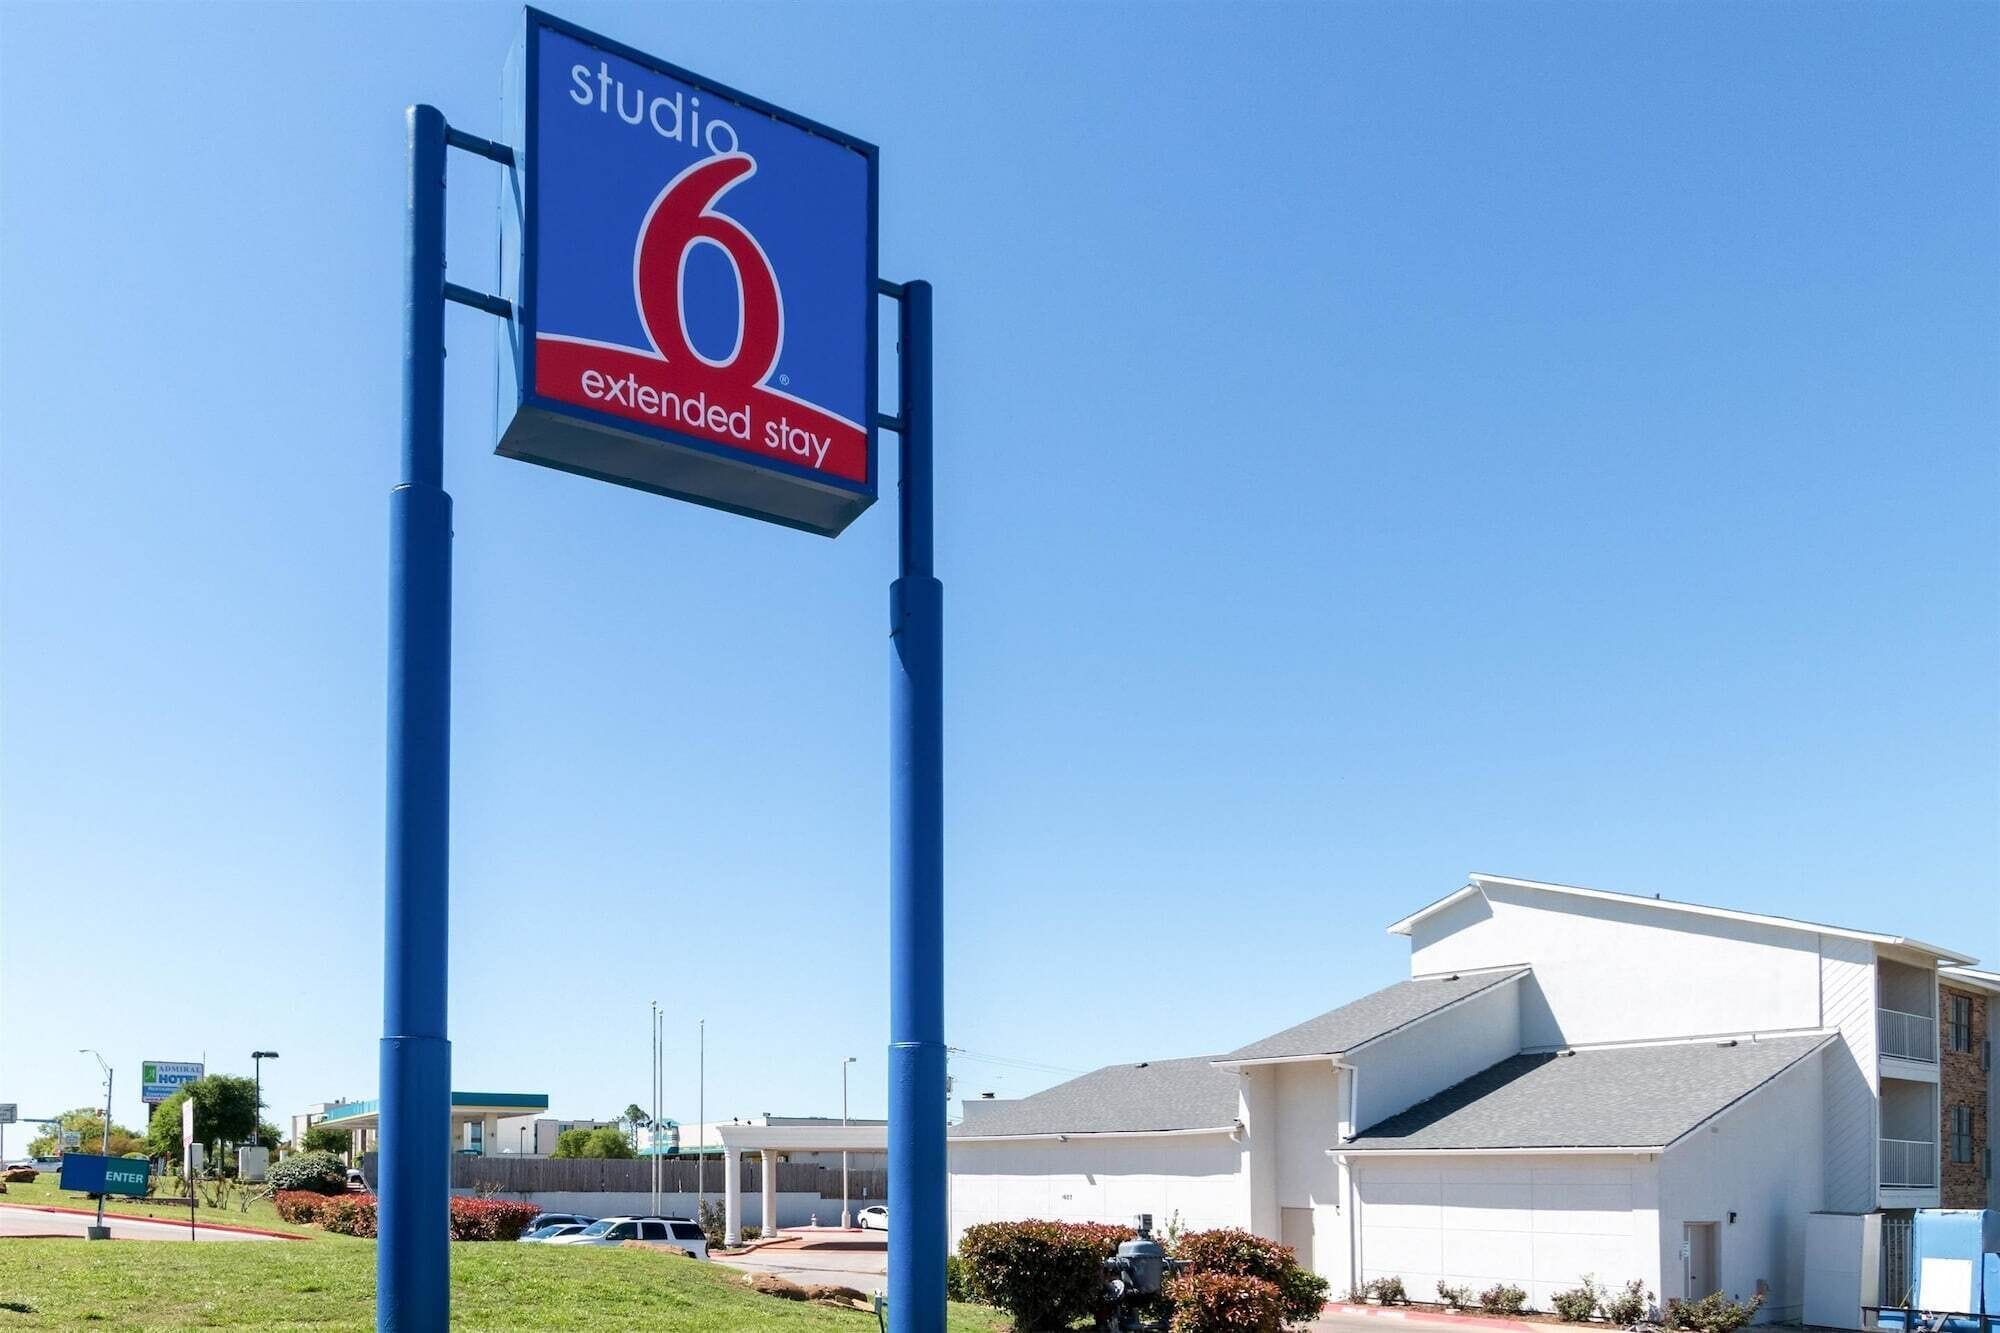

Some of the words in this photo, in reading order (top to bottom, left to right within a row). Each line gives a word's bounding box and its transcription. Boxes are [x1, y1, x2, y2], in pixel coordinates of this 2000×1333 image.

[569, 61, 739, 156] studio
[633, 151, 785, 388] 6
[580, 368, 751, 441] extended
[763, 419, 832, 469] stay
[159, 1064, 202, 1073] ADMIRAL
[105, 1171, 144, 1184] ENTER
